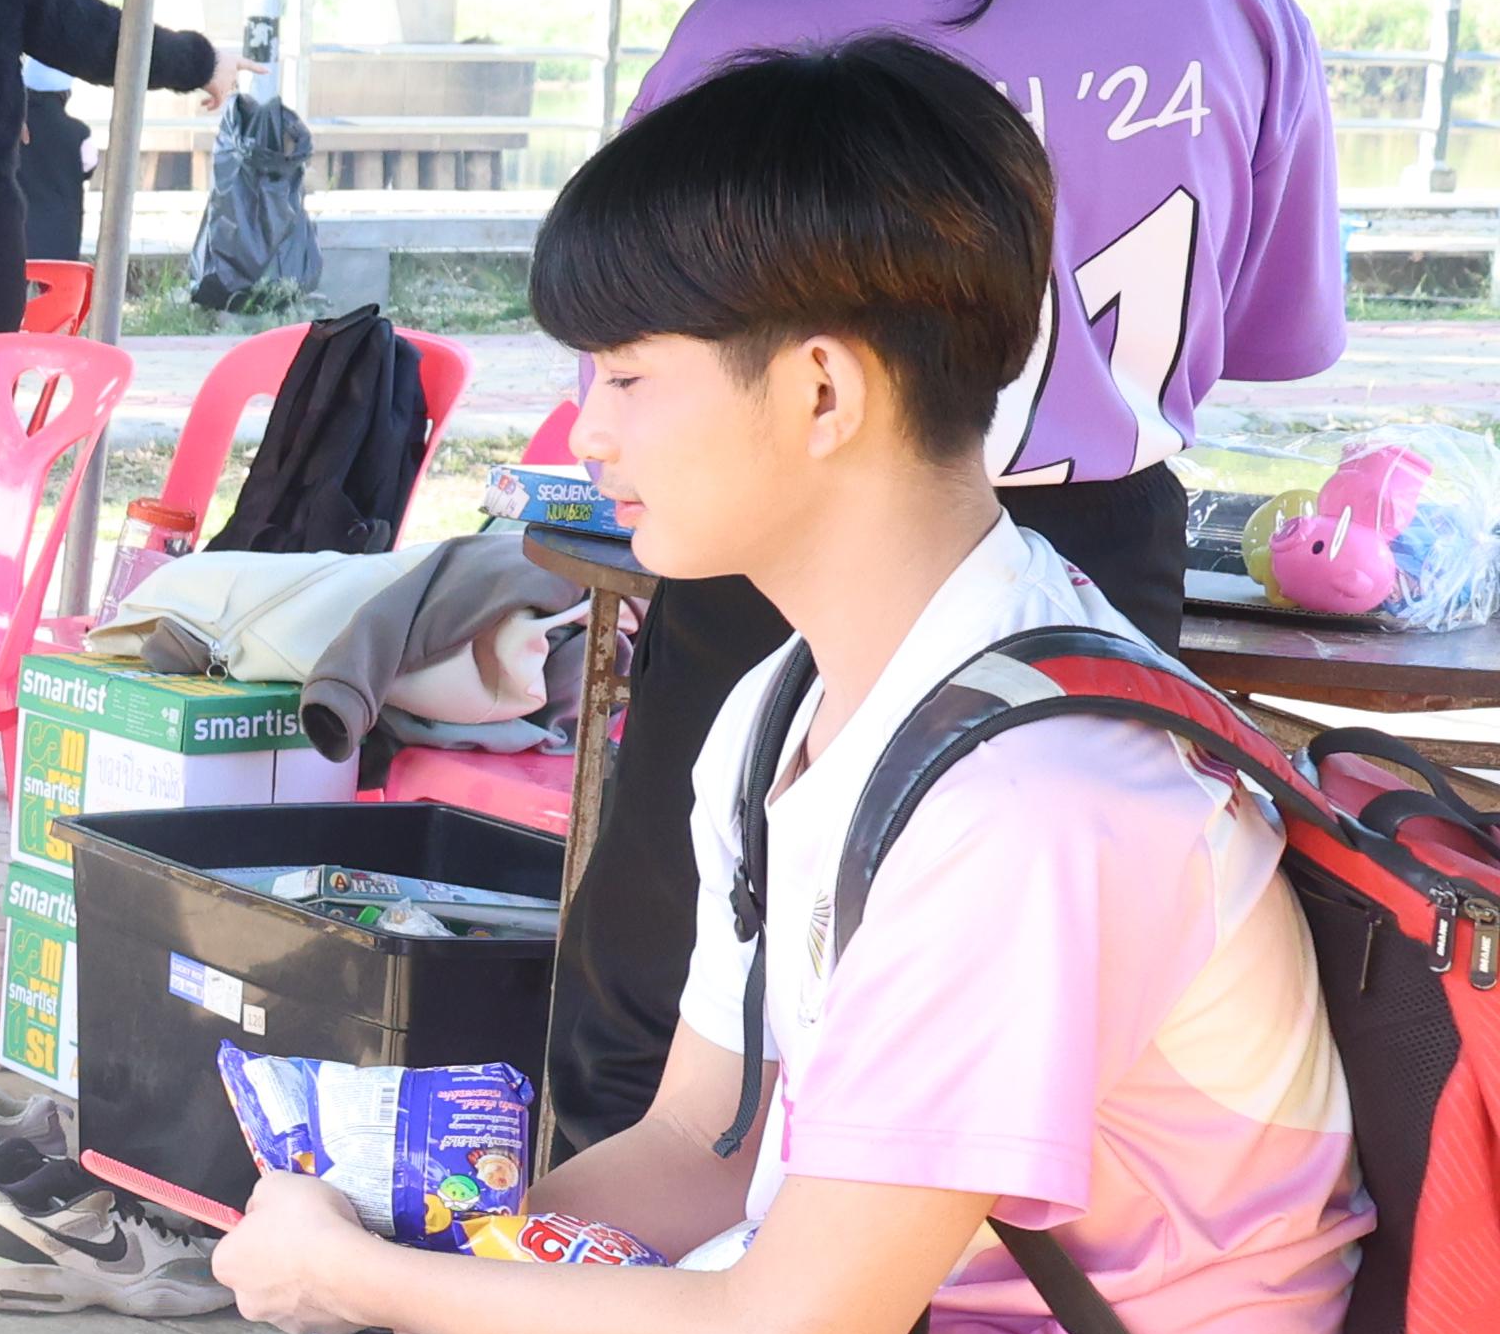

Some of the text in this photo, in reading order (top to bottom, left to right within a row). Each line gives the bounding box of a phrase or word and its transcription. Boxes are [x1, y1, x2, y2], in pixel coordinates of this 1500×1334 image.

[22, 667, 108, 715] smartist
[24, 774, 81, 808] smartist
[9, 880, 77, 928] smartis
[9, 981, 58, 1017] smartist
